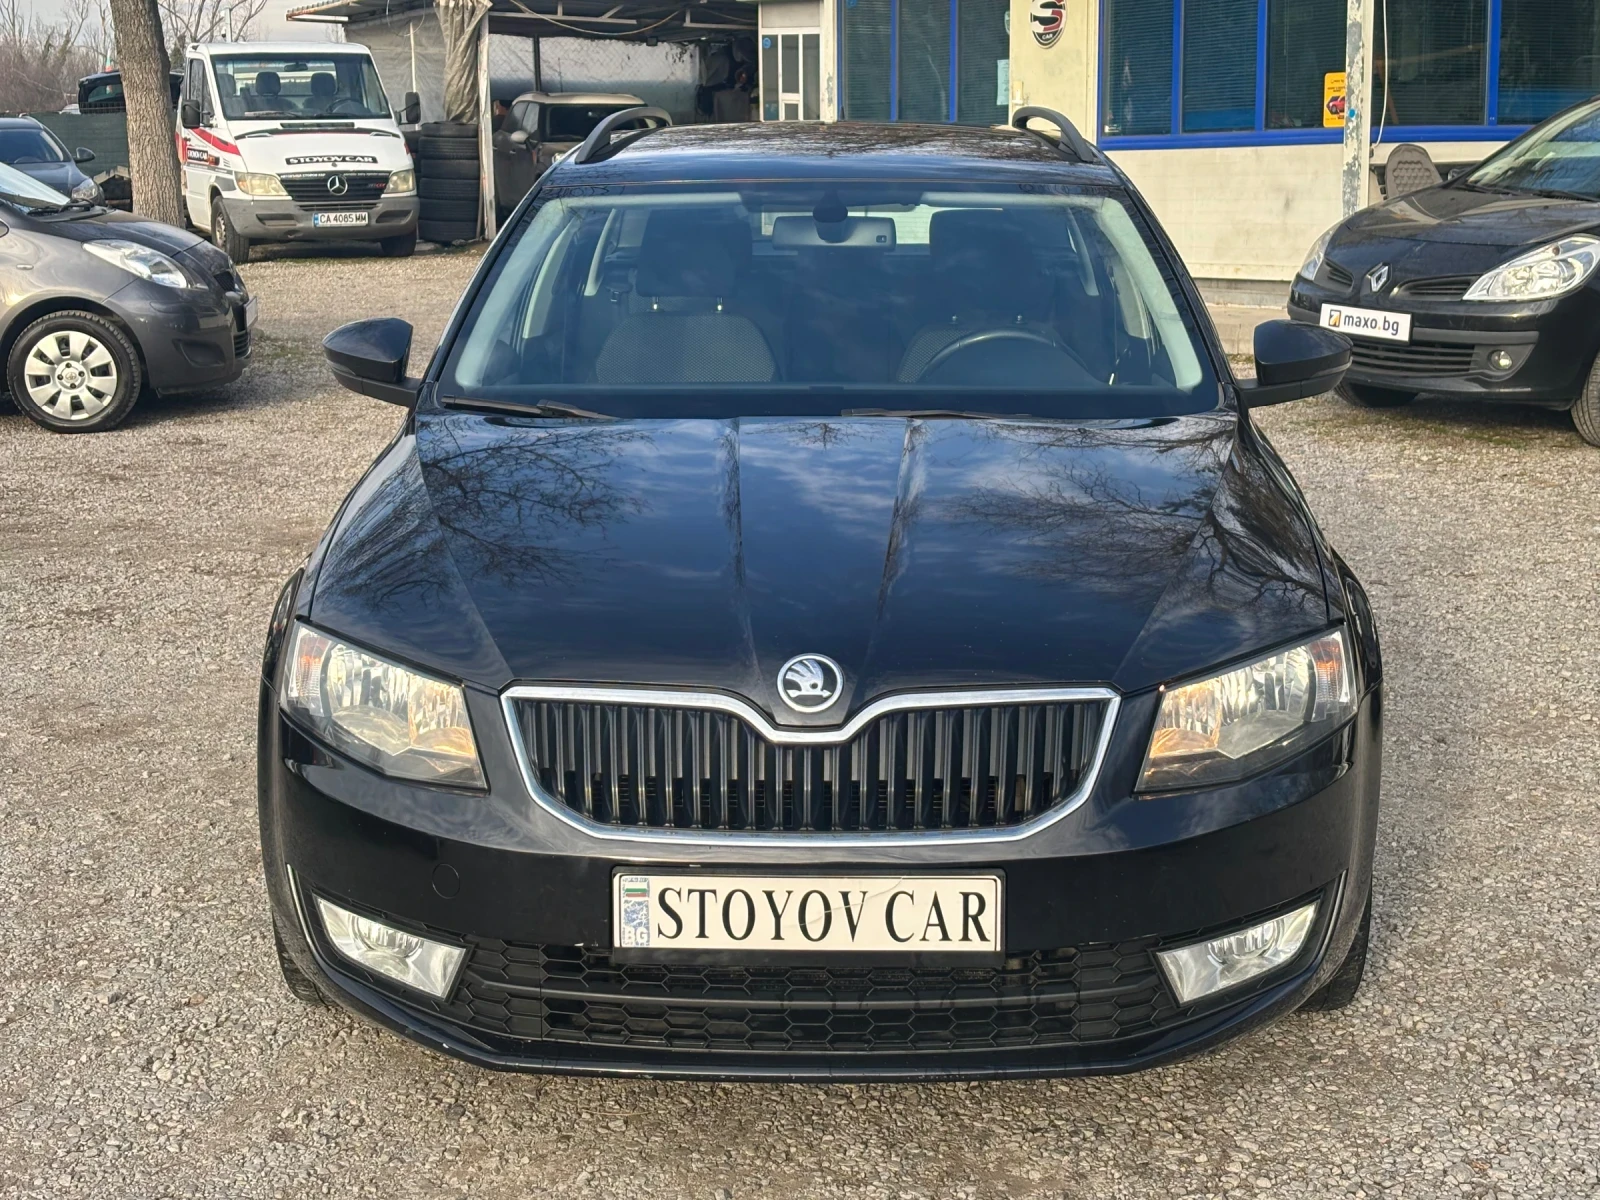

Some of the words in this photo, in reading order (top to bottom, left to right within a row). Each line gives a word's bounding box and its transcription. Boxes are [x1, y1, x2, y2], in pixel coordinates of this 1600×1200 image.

[289, 156, 343, 164] STOYOV
[319, 213, 331, 223] CA
[333, 213, 354, 223] 4085
[1343, 314, 1400, 336] maxo.bg
[657, 887, 869, 943] STOYOV
[885, 889, 991, 943] CAR
